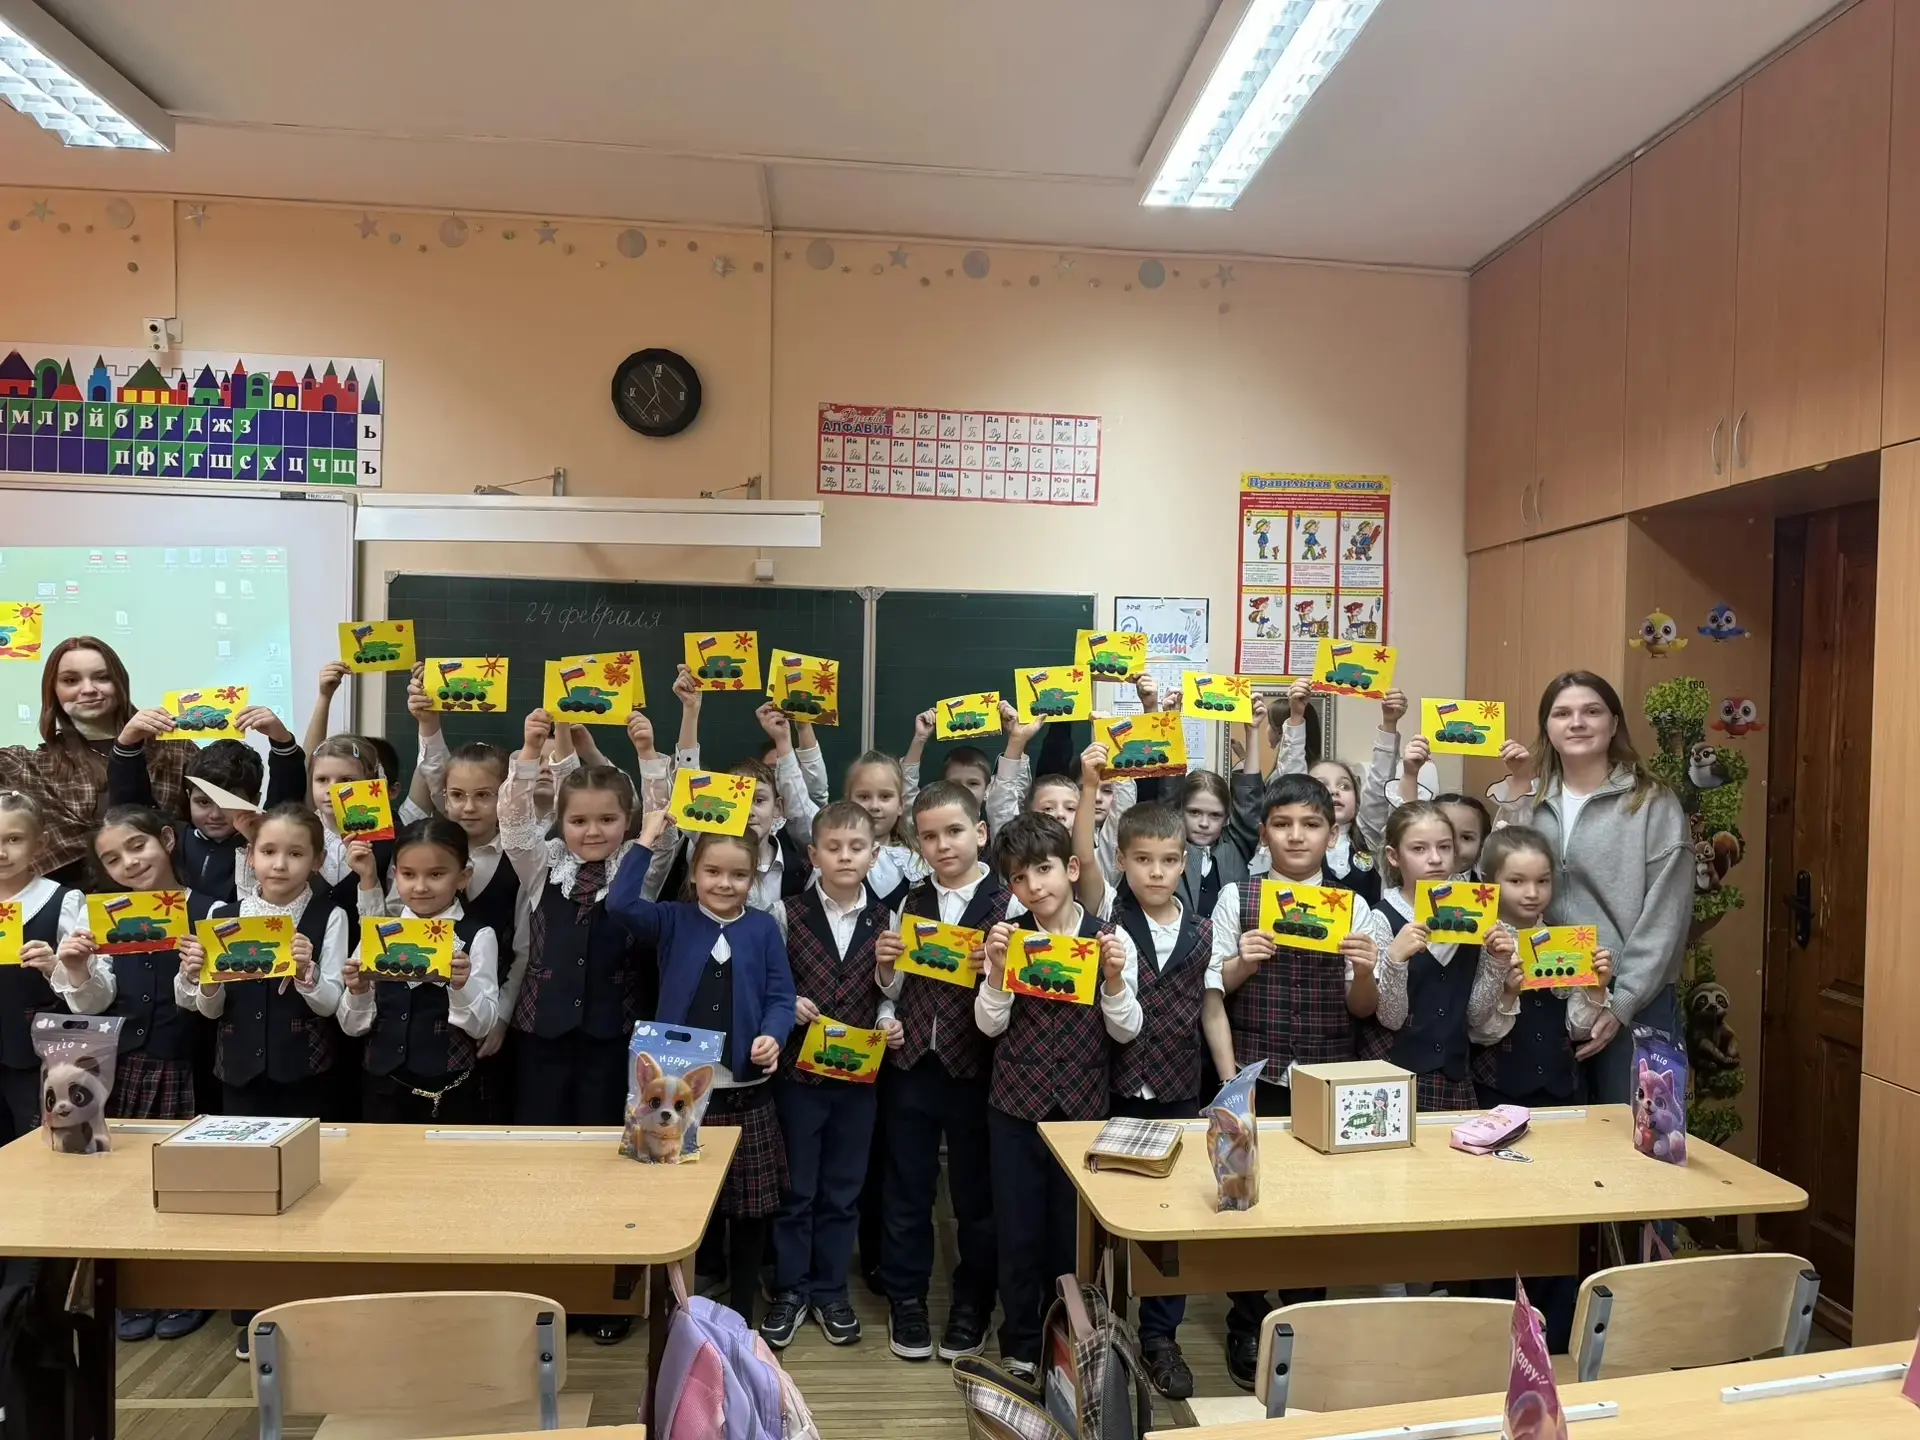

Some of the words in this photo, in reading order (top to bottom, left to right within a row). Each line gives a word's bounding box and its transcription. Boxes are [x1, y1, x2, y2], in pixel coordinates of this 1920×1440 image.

[12, 410, 30, 424] м
[37, 411, 53, 425] л
[64, 411, 79, 431] р
[89, 408, 104, 427] й
[114, 409, 128, 428] б
[139, 415, 154, 429] в
[165, 416, 178, 431] г
[188, 417, 203, 434] д
[212, 418, 233, 433] ж
[240, 420, 251, 433] з
[842, 407, 886, 425] Русский
[823, 421, 893, 435] АЛФАВИТ
[115, 450, 130, 465] п
[136, 446, 155, 471] ф
[164, 452, 180, 467] к
[189, 453, 203, 467] т
[210, 454, 233, 468] ш
[239, 455, 251, 470] с
[263, 456, 277, 471] х
[288, 457, 304, 474] ц
[312, 458, 327, 473] ч
[333, 459, 356, 476] щ
[1248, 476, 1331, 490] Правильная
[1335, 480, 1384, 490] осанка
[526, 602, 554, 624] 24
[559, 596, 664, 638] февраля
[1688, 680, 1705, 689] 160
[1683, 1241, 1693, 1250] 10
[1516, 1346, 1540, 1382] appy
